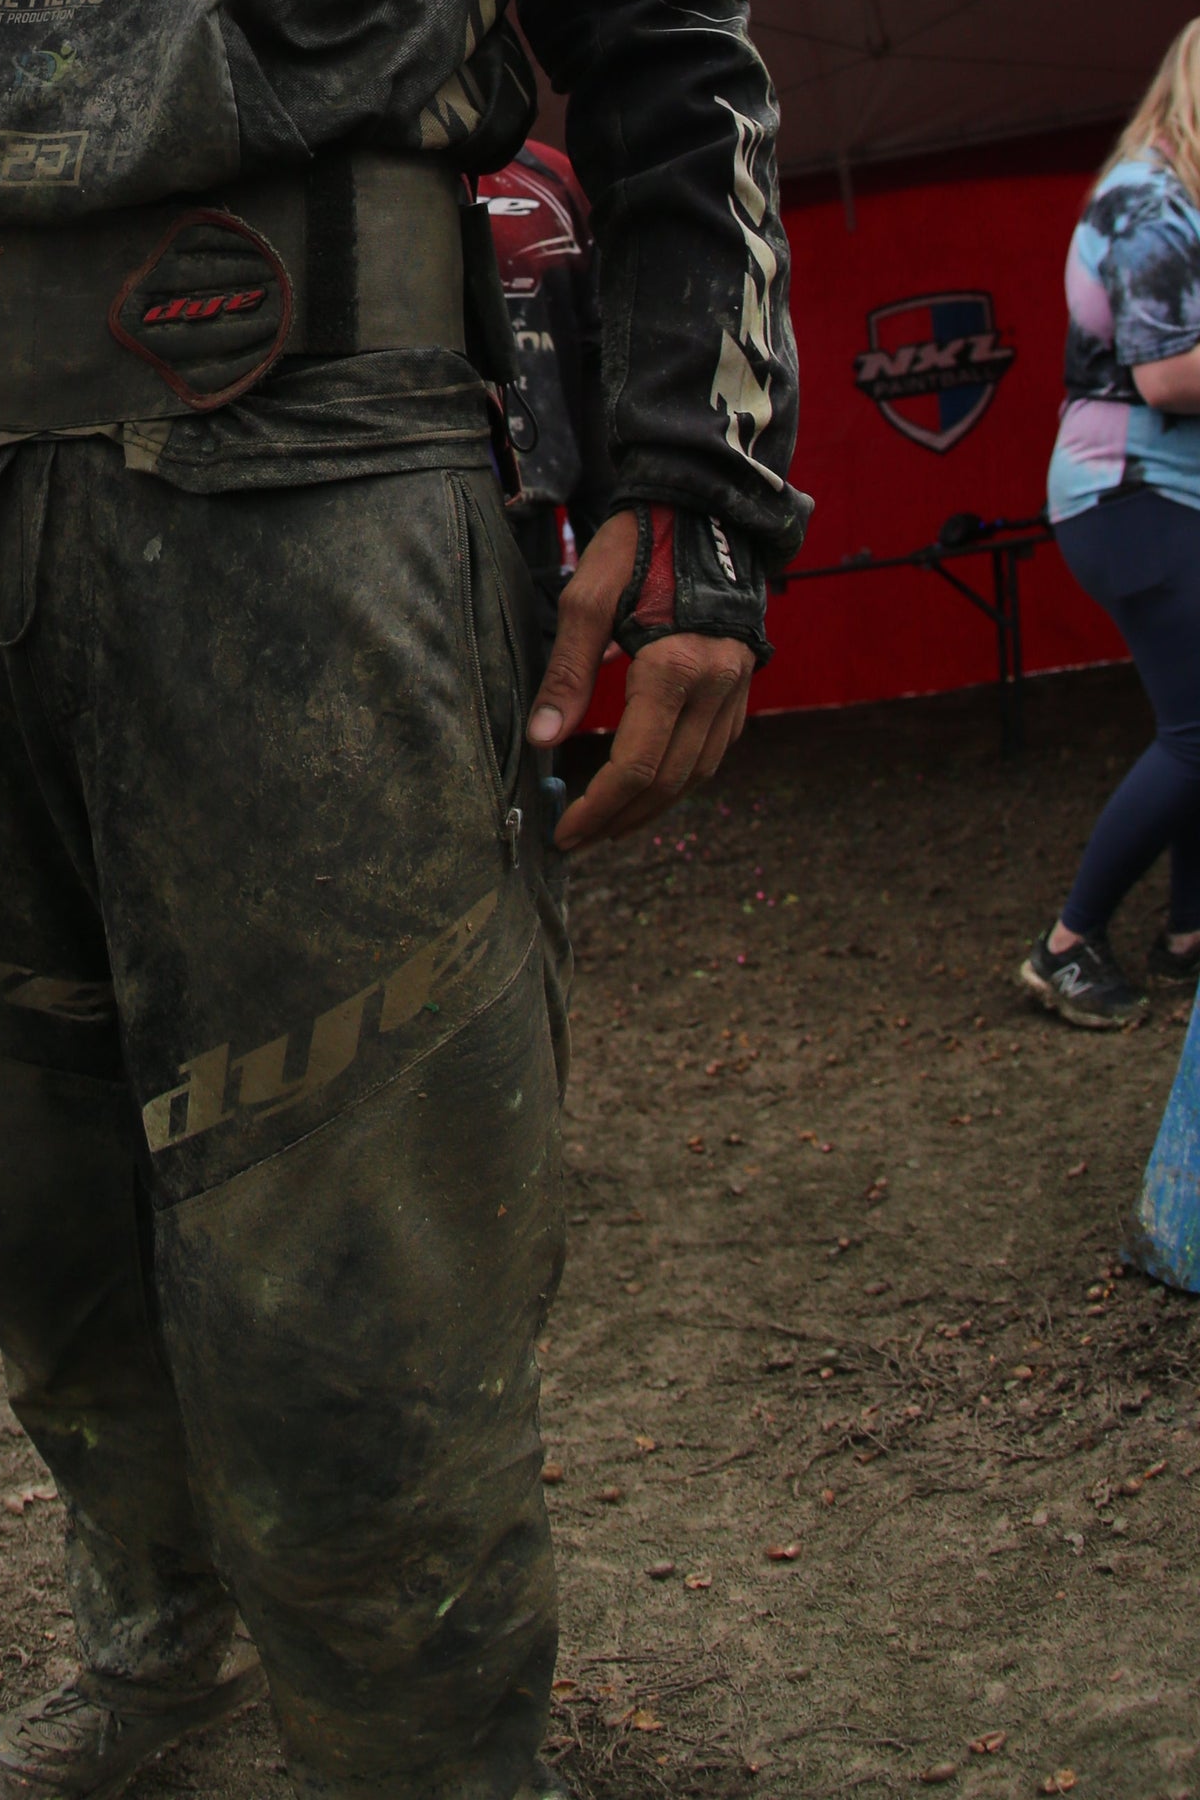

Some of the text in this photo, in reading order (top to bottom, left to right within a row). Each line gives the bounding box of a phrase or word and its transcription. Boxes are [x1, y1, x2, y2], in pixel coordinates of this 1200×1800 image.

[6, 8, 75, 25] PRODUCTION
[143, 289, 264, 323] dye
[853, 333, 1015, 381] NXL
[143, 891, 500, 1154] dye
